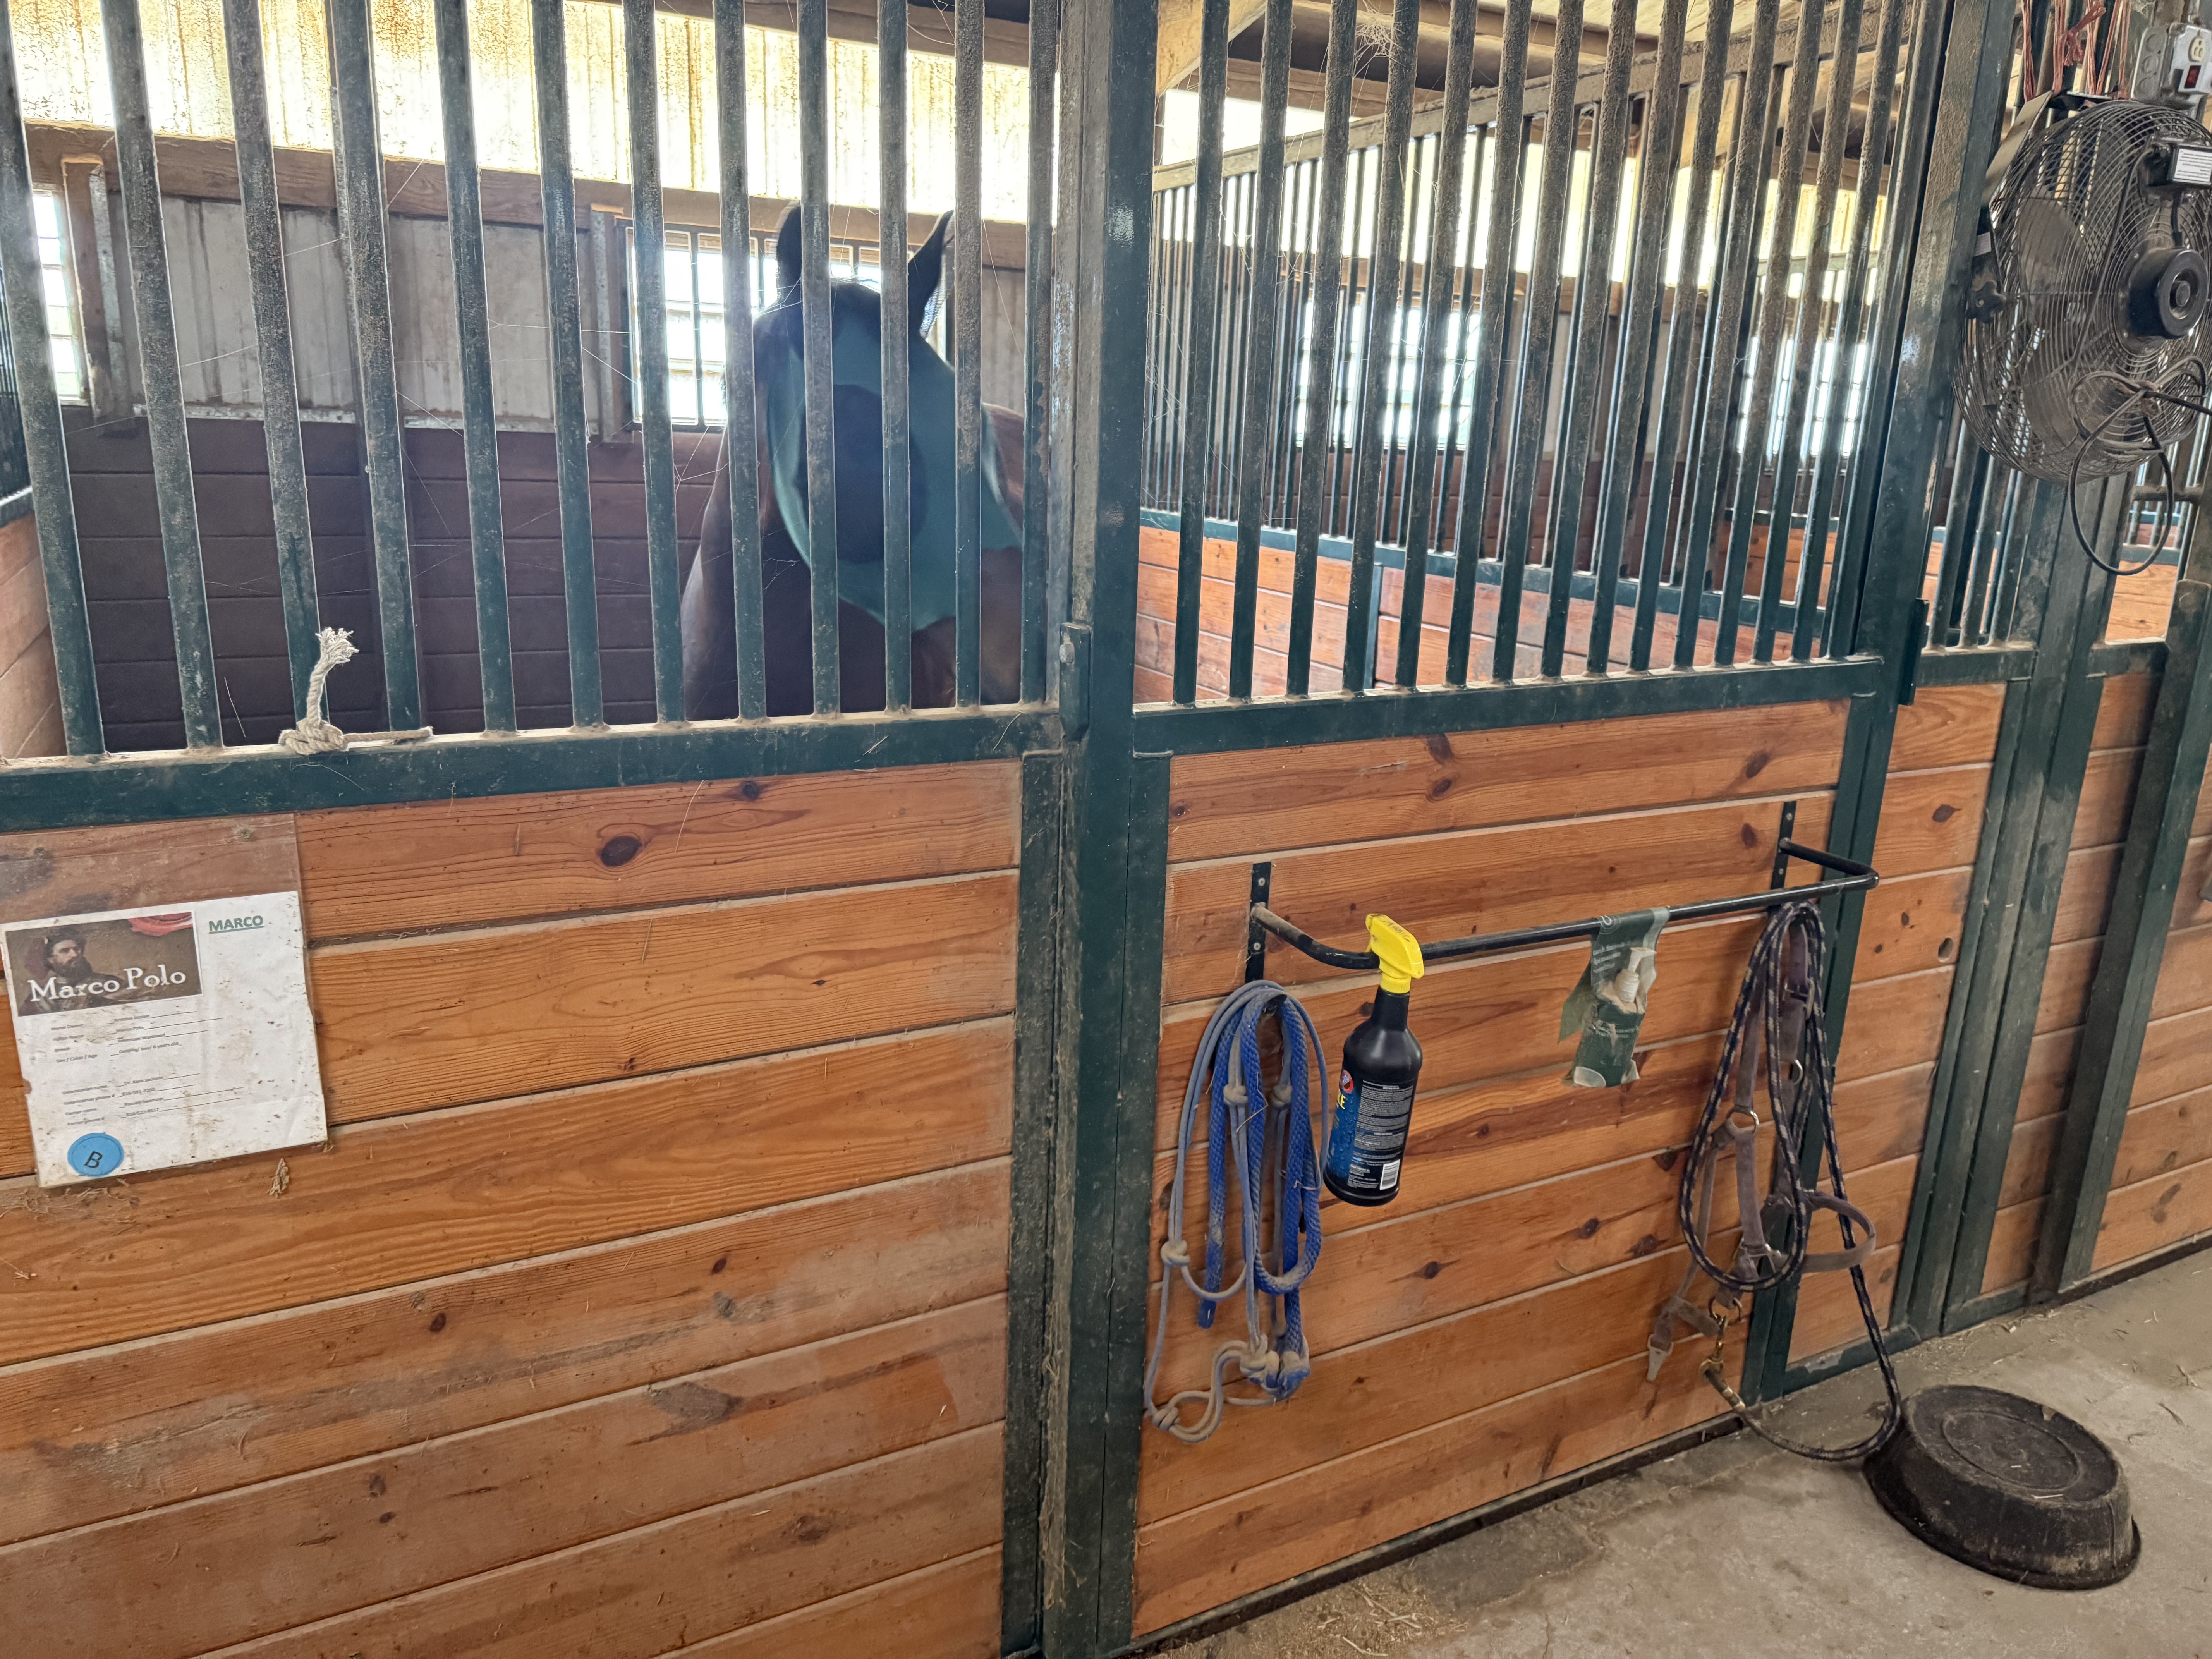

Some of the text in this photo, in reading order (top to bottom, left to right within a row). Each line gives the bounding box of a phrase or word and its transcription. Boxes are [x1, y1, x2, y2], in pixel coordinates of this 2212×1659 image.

[208, 915, 264, 932] MARCO
[27, 964, 186, 1002] Marco Polo
[84, 1151, 103, 1168] B
